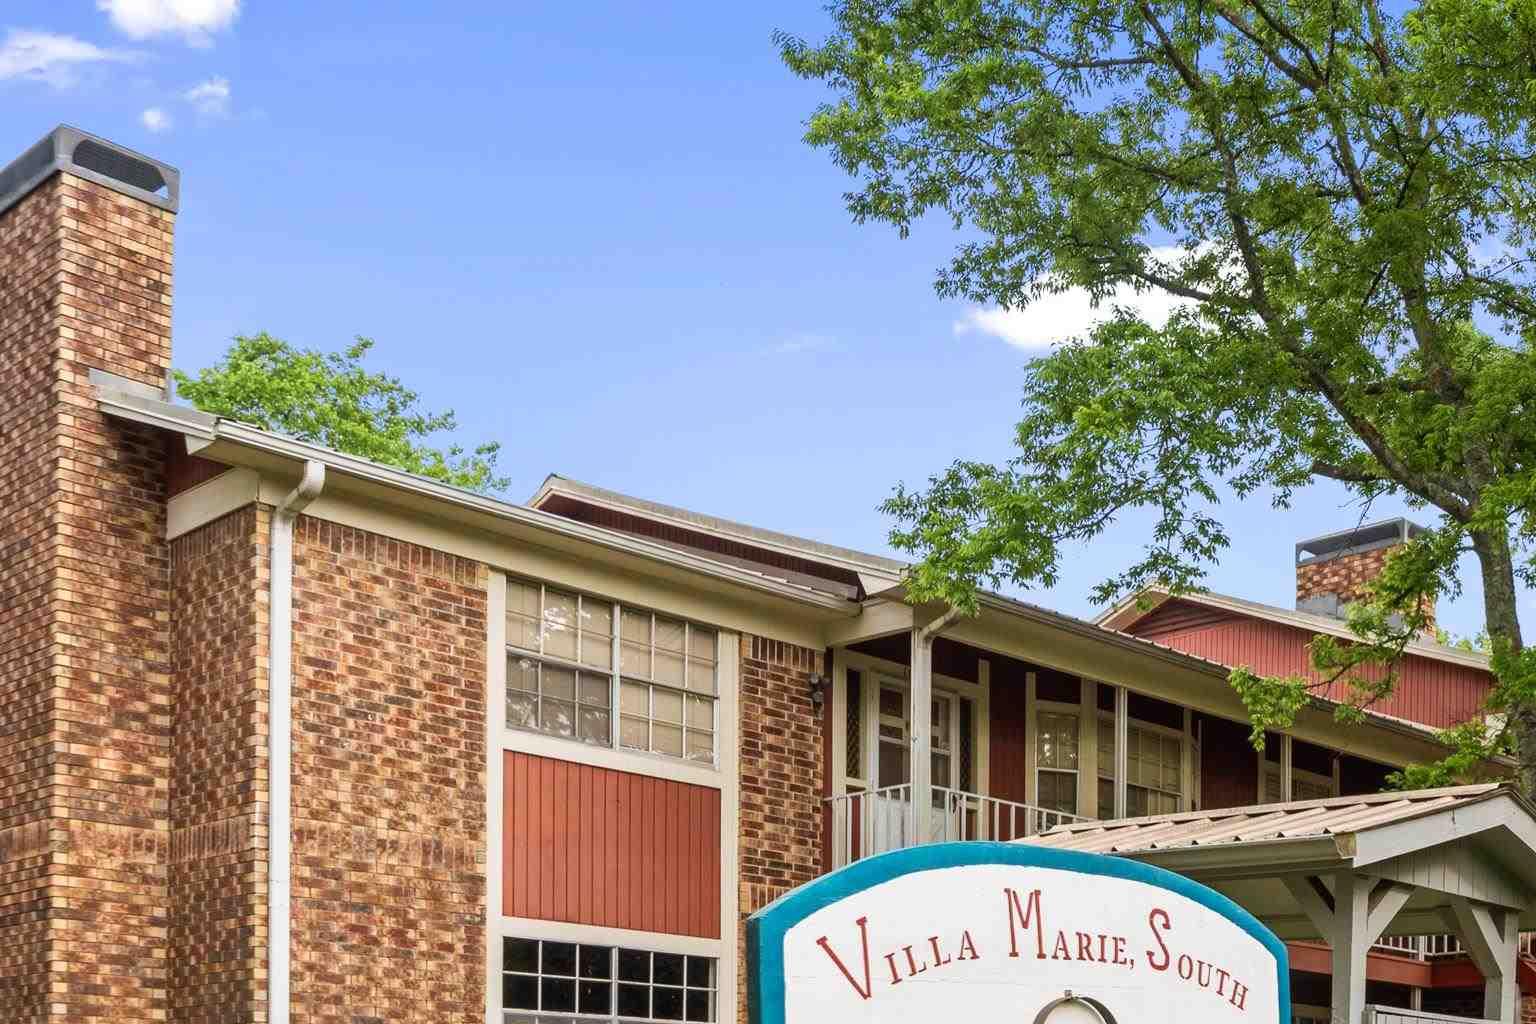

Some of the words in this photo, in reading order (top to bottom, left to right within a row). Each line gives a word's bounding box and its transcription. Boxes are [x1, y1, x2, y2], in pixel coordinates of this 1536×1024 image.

[815, 916, 981, 1000] VILLA
[1004, 887, 1135, 970] MARIE,
[1146, 907, 1248, 1011] SOUTH
